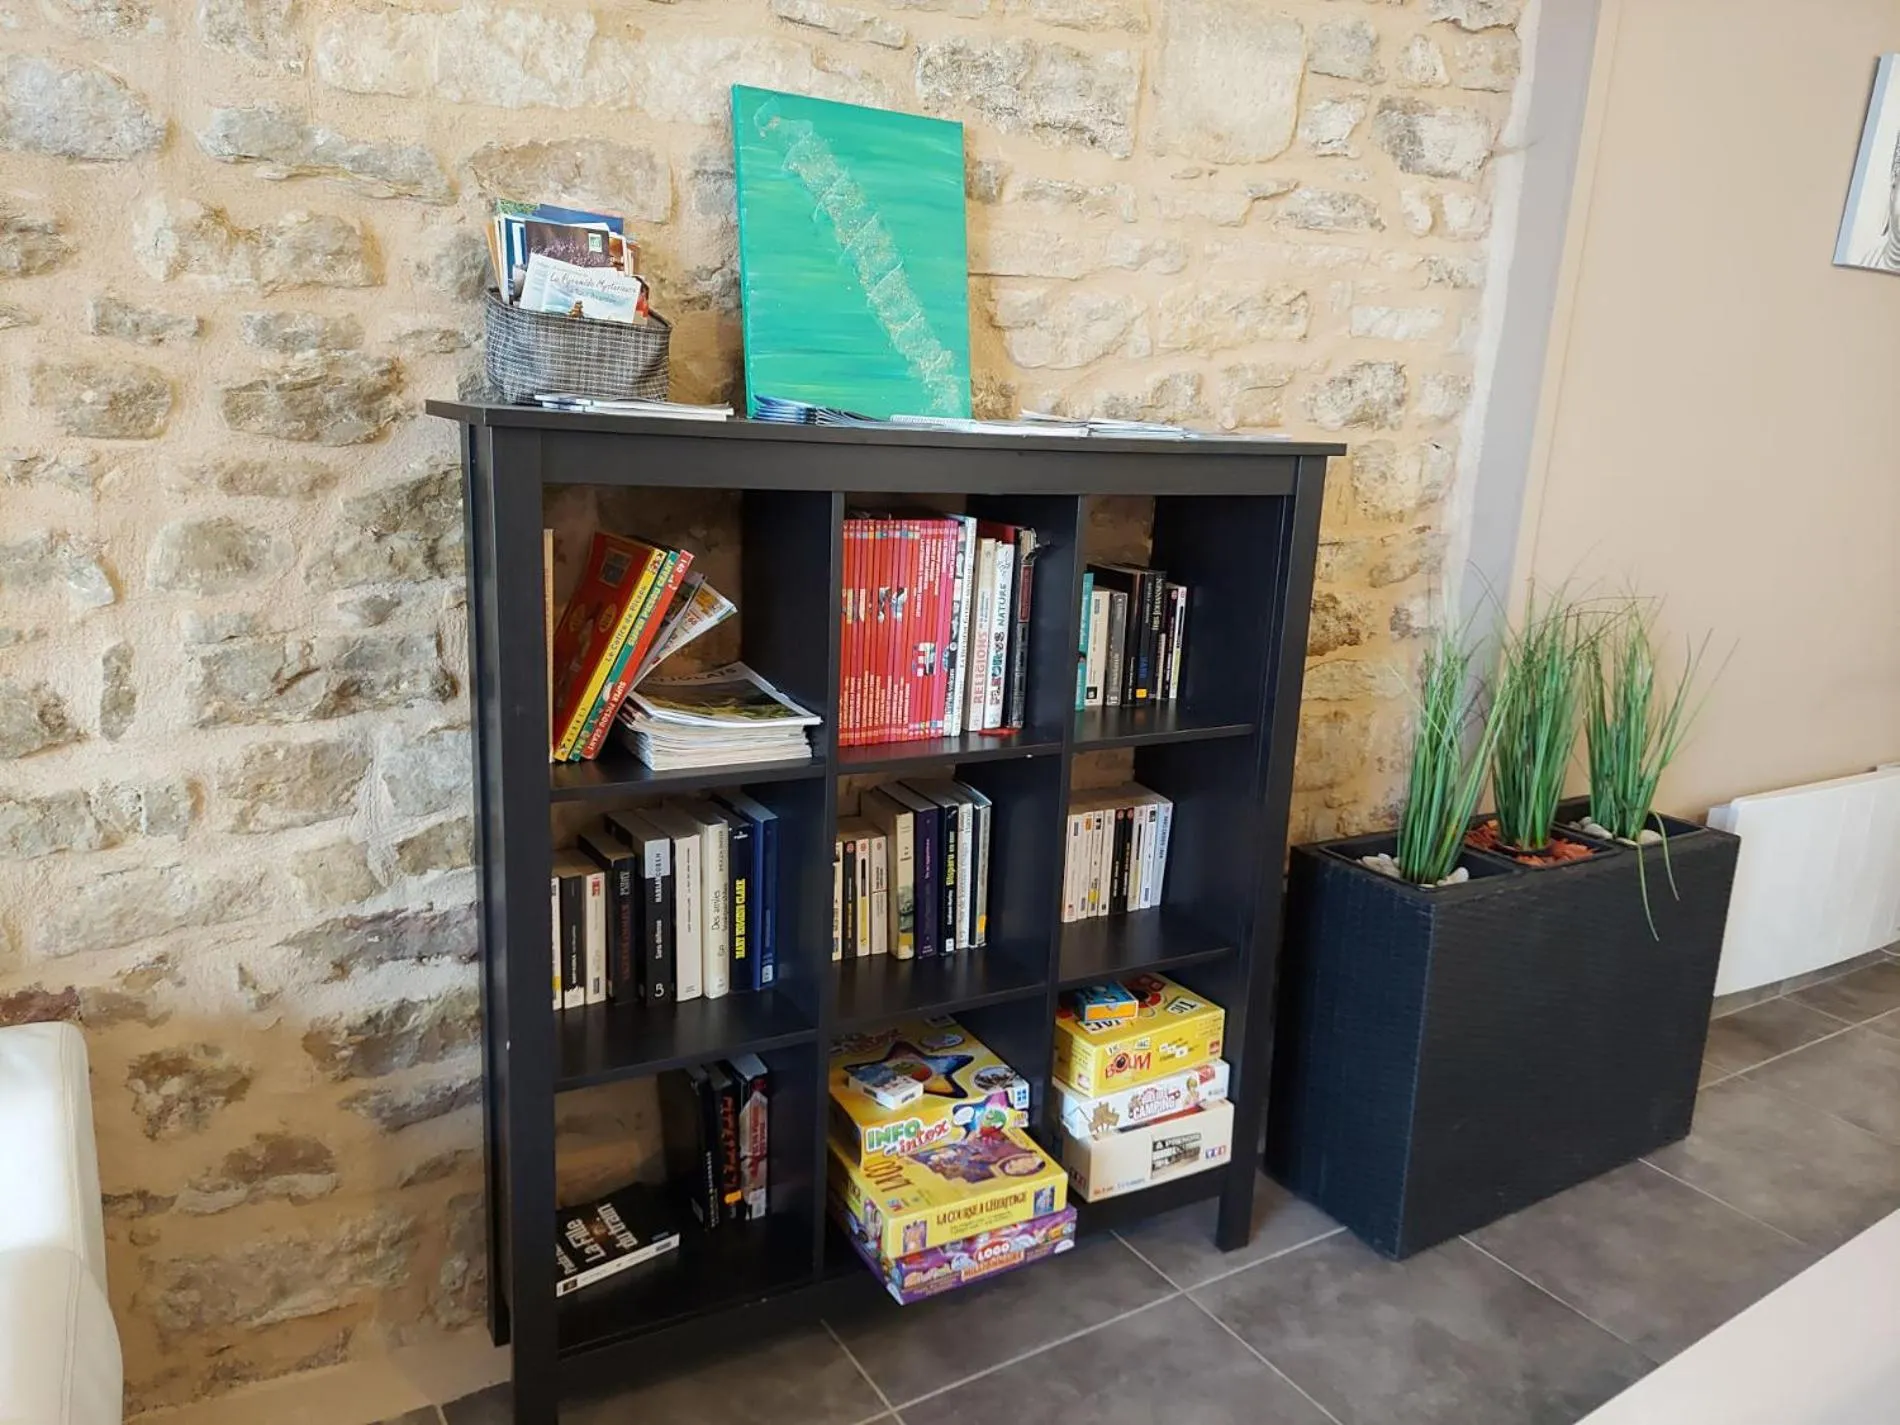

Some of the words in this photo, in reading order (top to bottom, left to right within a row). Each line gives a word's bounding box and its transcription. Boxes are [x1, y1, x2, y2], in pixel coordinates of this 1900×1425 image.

[998, 583, 1008, 626] NATURE
[972, 631, 988, 704] RELIGIONS
[736, 879, 745, 903] CLARK
[1106, 1052, 1151, 1079] BOUM
[867, 1120, 921, 1150] INFO
[899, 1120, 950, 1154] intox
[596, 1202, 628, 1233] train
[564, 1218, 591, 1248] Fille
[615, 1228, 638, 1250] du
[583, 1241, 608, 1264] La
